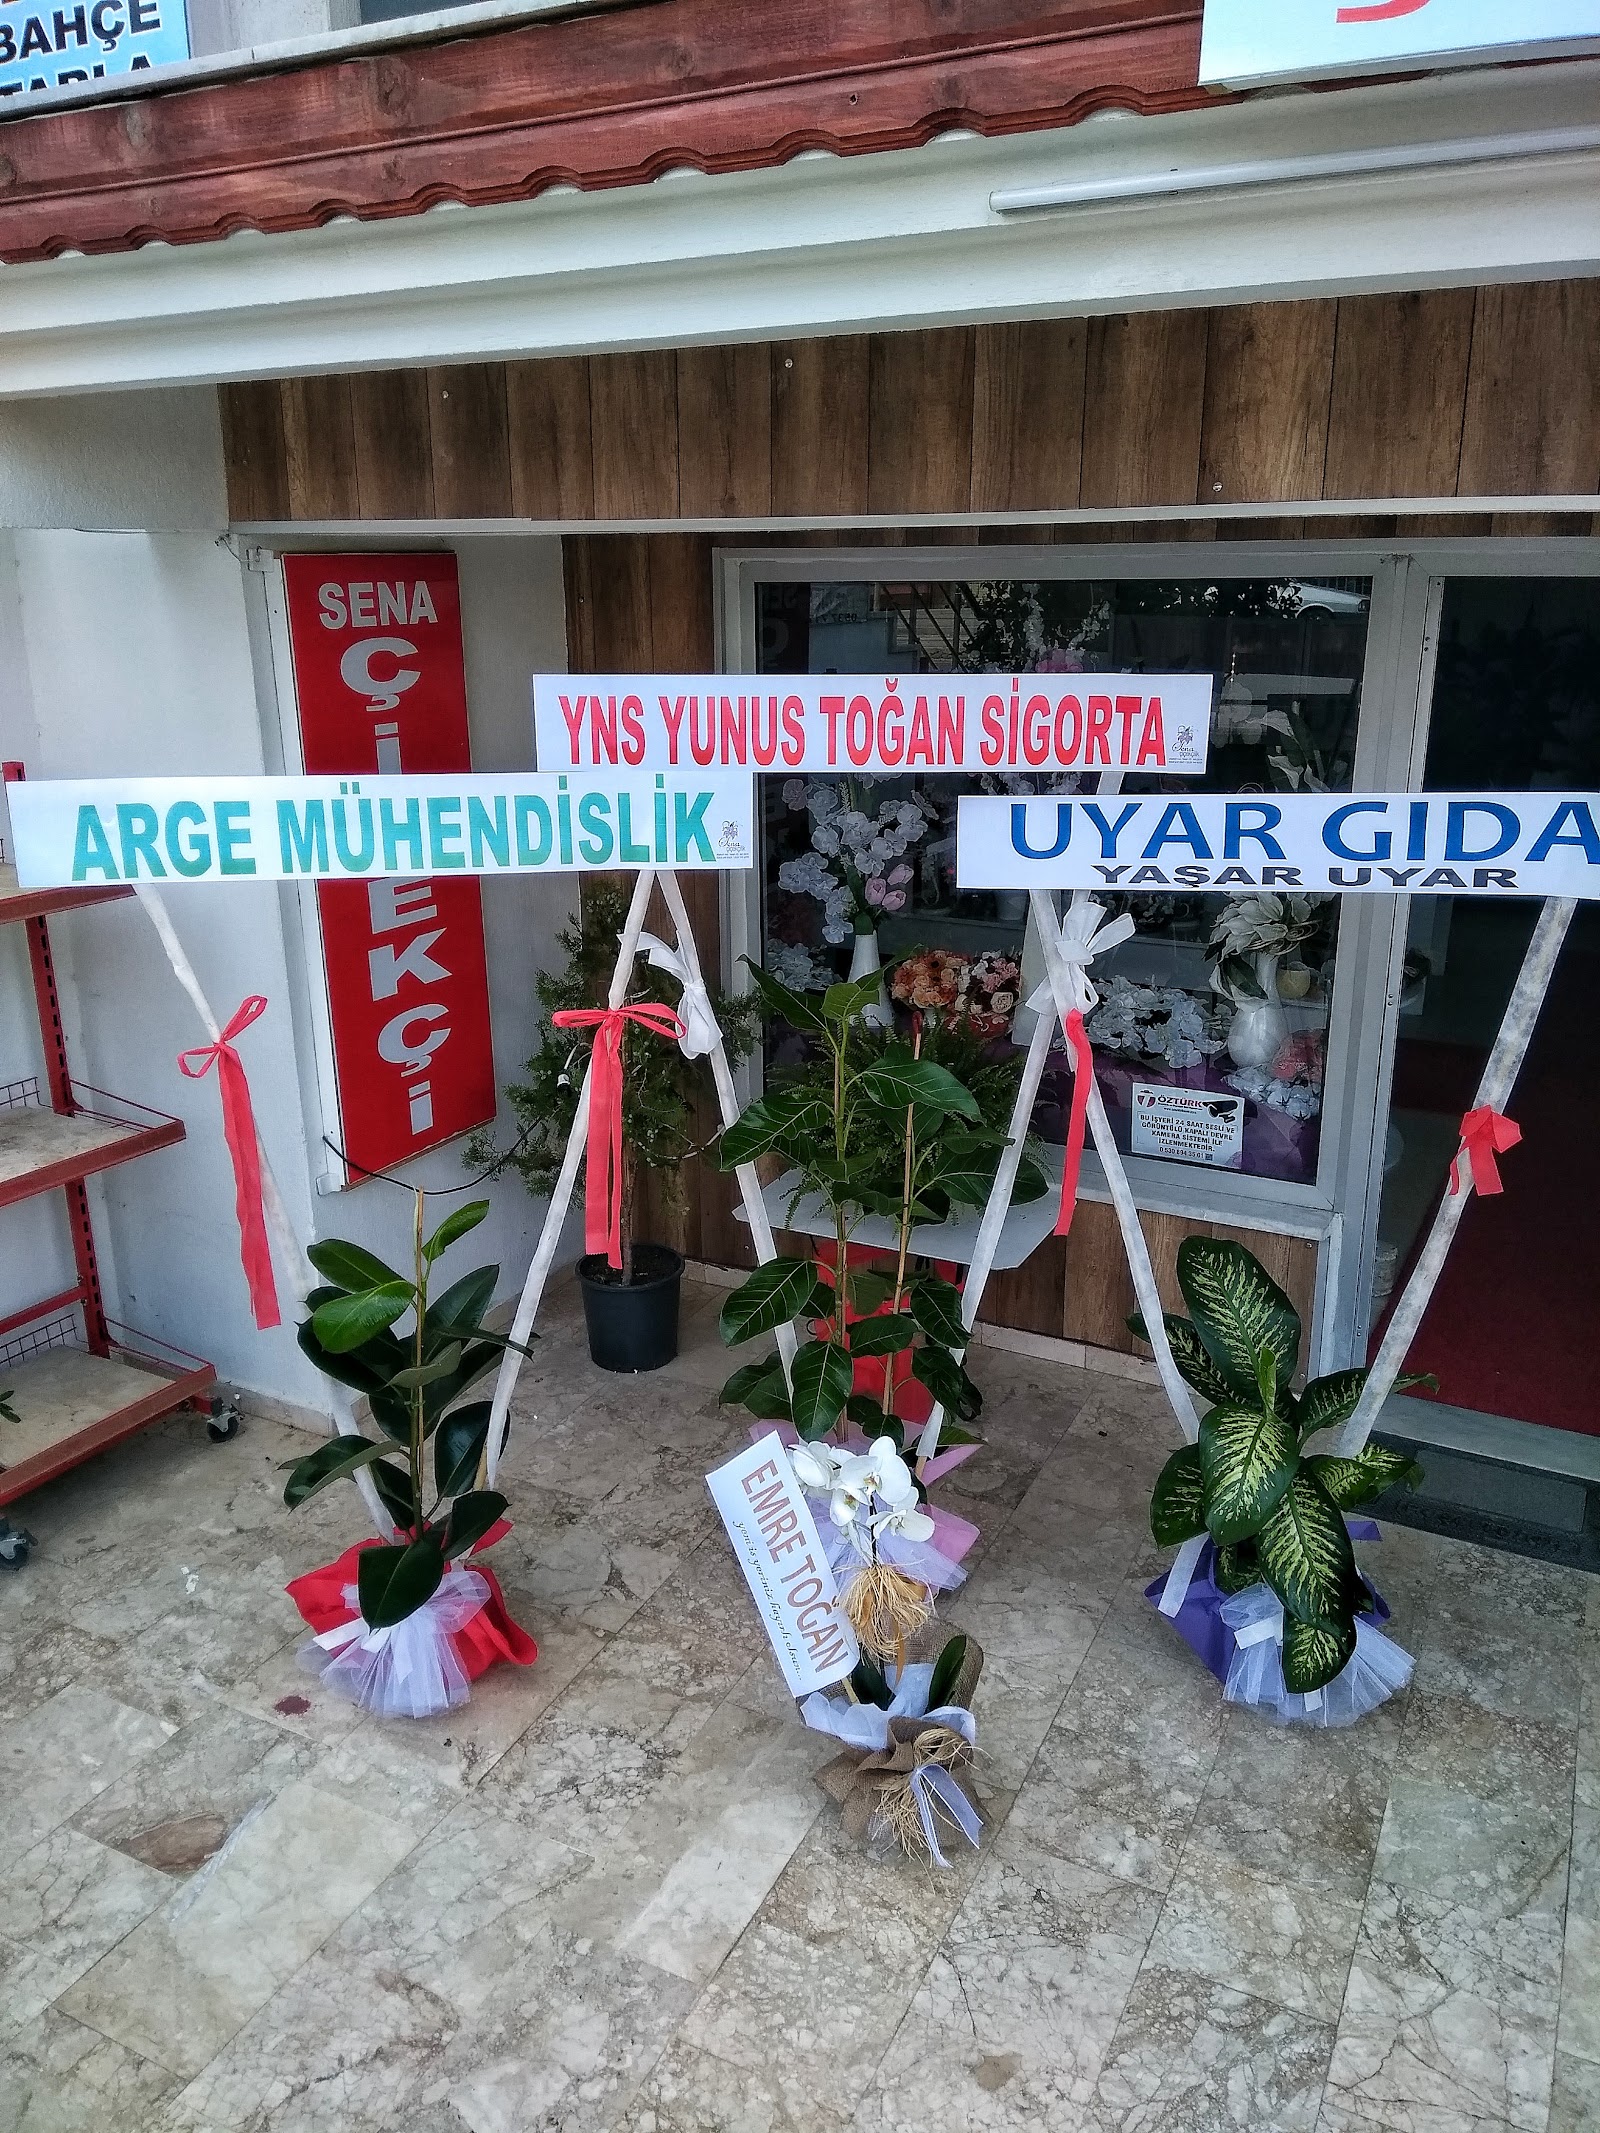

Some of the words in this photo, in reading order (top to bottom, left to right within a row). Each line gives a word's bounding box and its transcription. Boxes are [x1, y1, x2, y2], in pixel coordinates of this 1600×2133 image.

[318, 580, 438, 630] SENA
[561, 696, 645, 766] YNS
[660, 696, 805, 766] YUNUS
[819, 680, 965, 766] TOĞAN
[980, 679, 1166, 766] SİGORTA
[72, 799, 257, 881] ARGE
[276, 774, 717, 874] MÜHENDİSLİK
[1010, 802, 1287, 860] UYAR
[1321, 801, 1600, 865] GIDA
[340, 637, 452, 1136] ÇİEKÇİ
[1091, 865, 1304, 888] YAŞAR
[1328, 867, 1519, 889] UYAR
[1157, 1094, 1202, 1107] ÖZTÜRK
[1186, 1120, 1203, 1129] SAAT
[1226, 1126, 1235, 1134] VE
[1151, 1130, 1180, 1140] KAMERA
[1210, 1131, 1233, 1141] DEVRE
[732, 1521, 755, 1545] yeni
[747, 1558, 774, 1600] yeriniz
[741, 1459, 806, 1564] EMRE
[780, 1554, 849, 1674] TOĞAN
